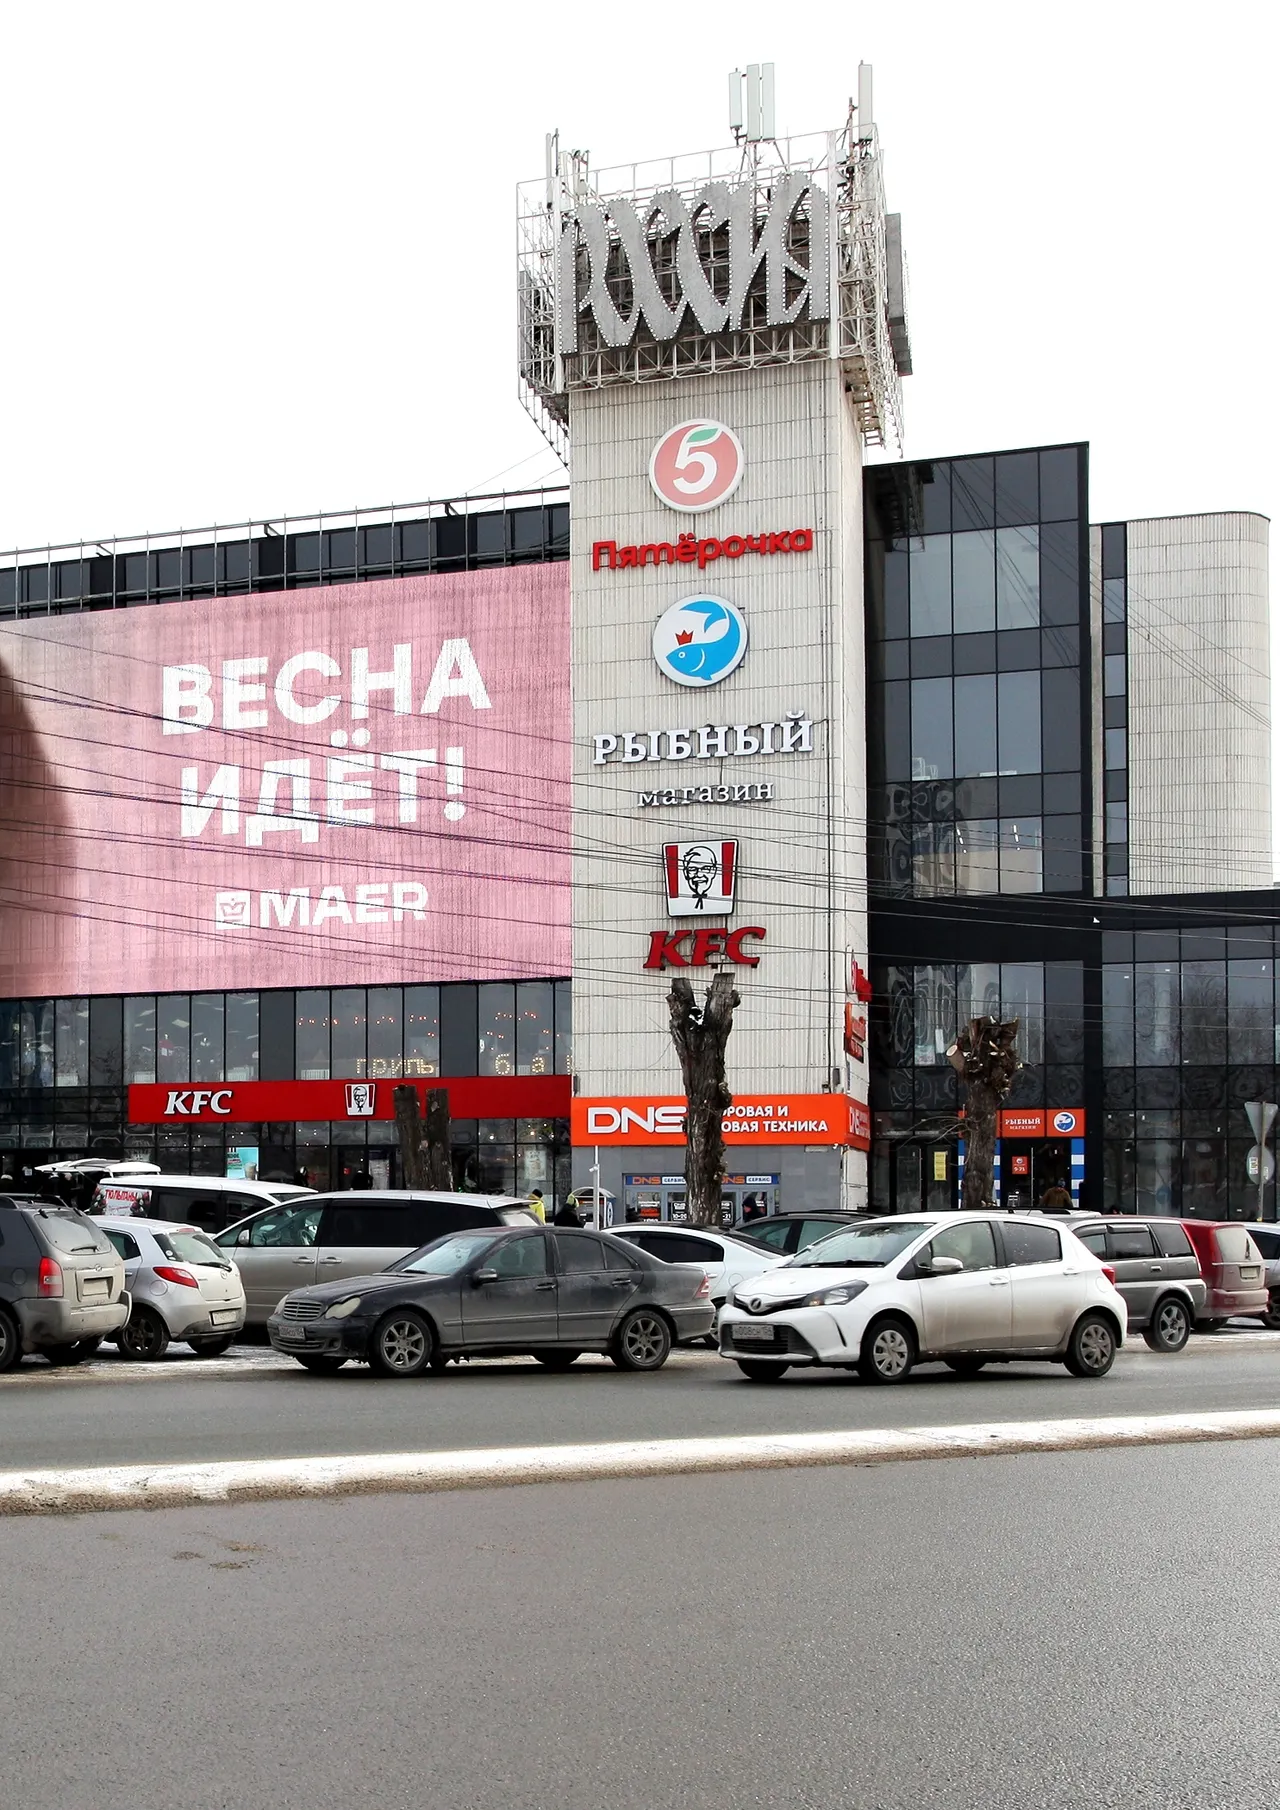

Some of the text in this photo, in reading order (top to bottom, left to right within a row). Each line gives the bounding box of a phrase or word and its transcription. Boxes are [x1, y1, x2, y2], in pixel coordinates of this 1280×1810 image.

[592, 526, 814, 572] Пятёрочка
[162, 637, 493, 736] ВЕСНА
[593, 709, 814, 766] РЫБНЫЙ
[180, 727, 467, 847] ИДЁТ!
[637, 781, 775, 808] магазин
[260, 881, 429, 929] MAER
[643, 926, 767, 970] KFC
[356, 1058, 435, 1080] гриль
[163, 1090, 233, 1115] KFC
[722, 1105, 788, 1117] РОВАЯ И
[587, 1105, 688, 1134] DNS
[721, 1120, 829, 1132] ОВАЯ ТЕХНИКА
[1005, 1116, 1041, 1125] РЫБНЫЙ
[632, 1176, 662, 1185] DNS
